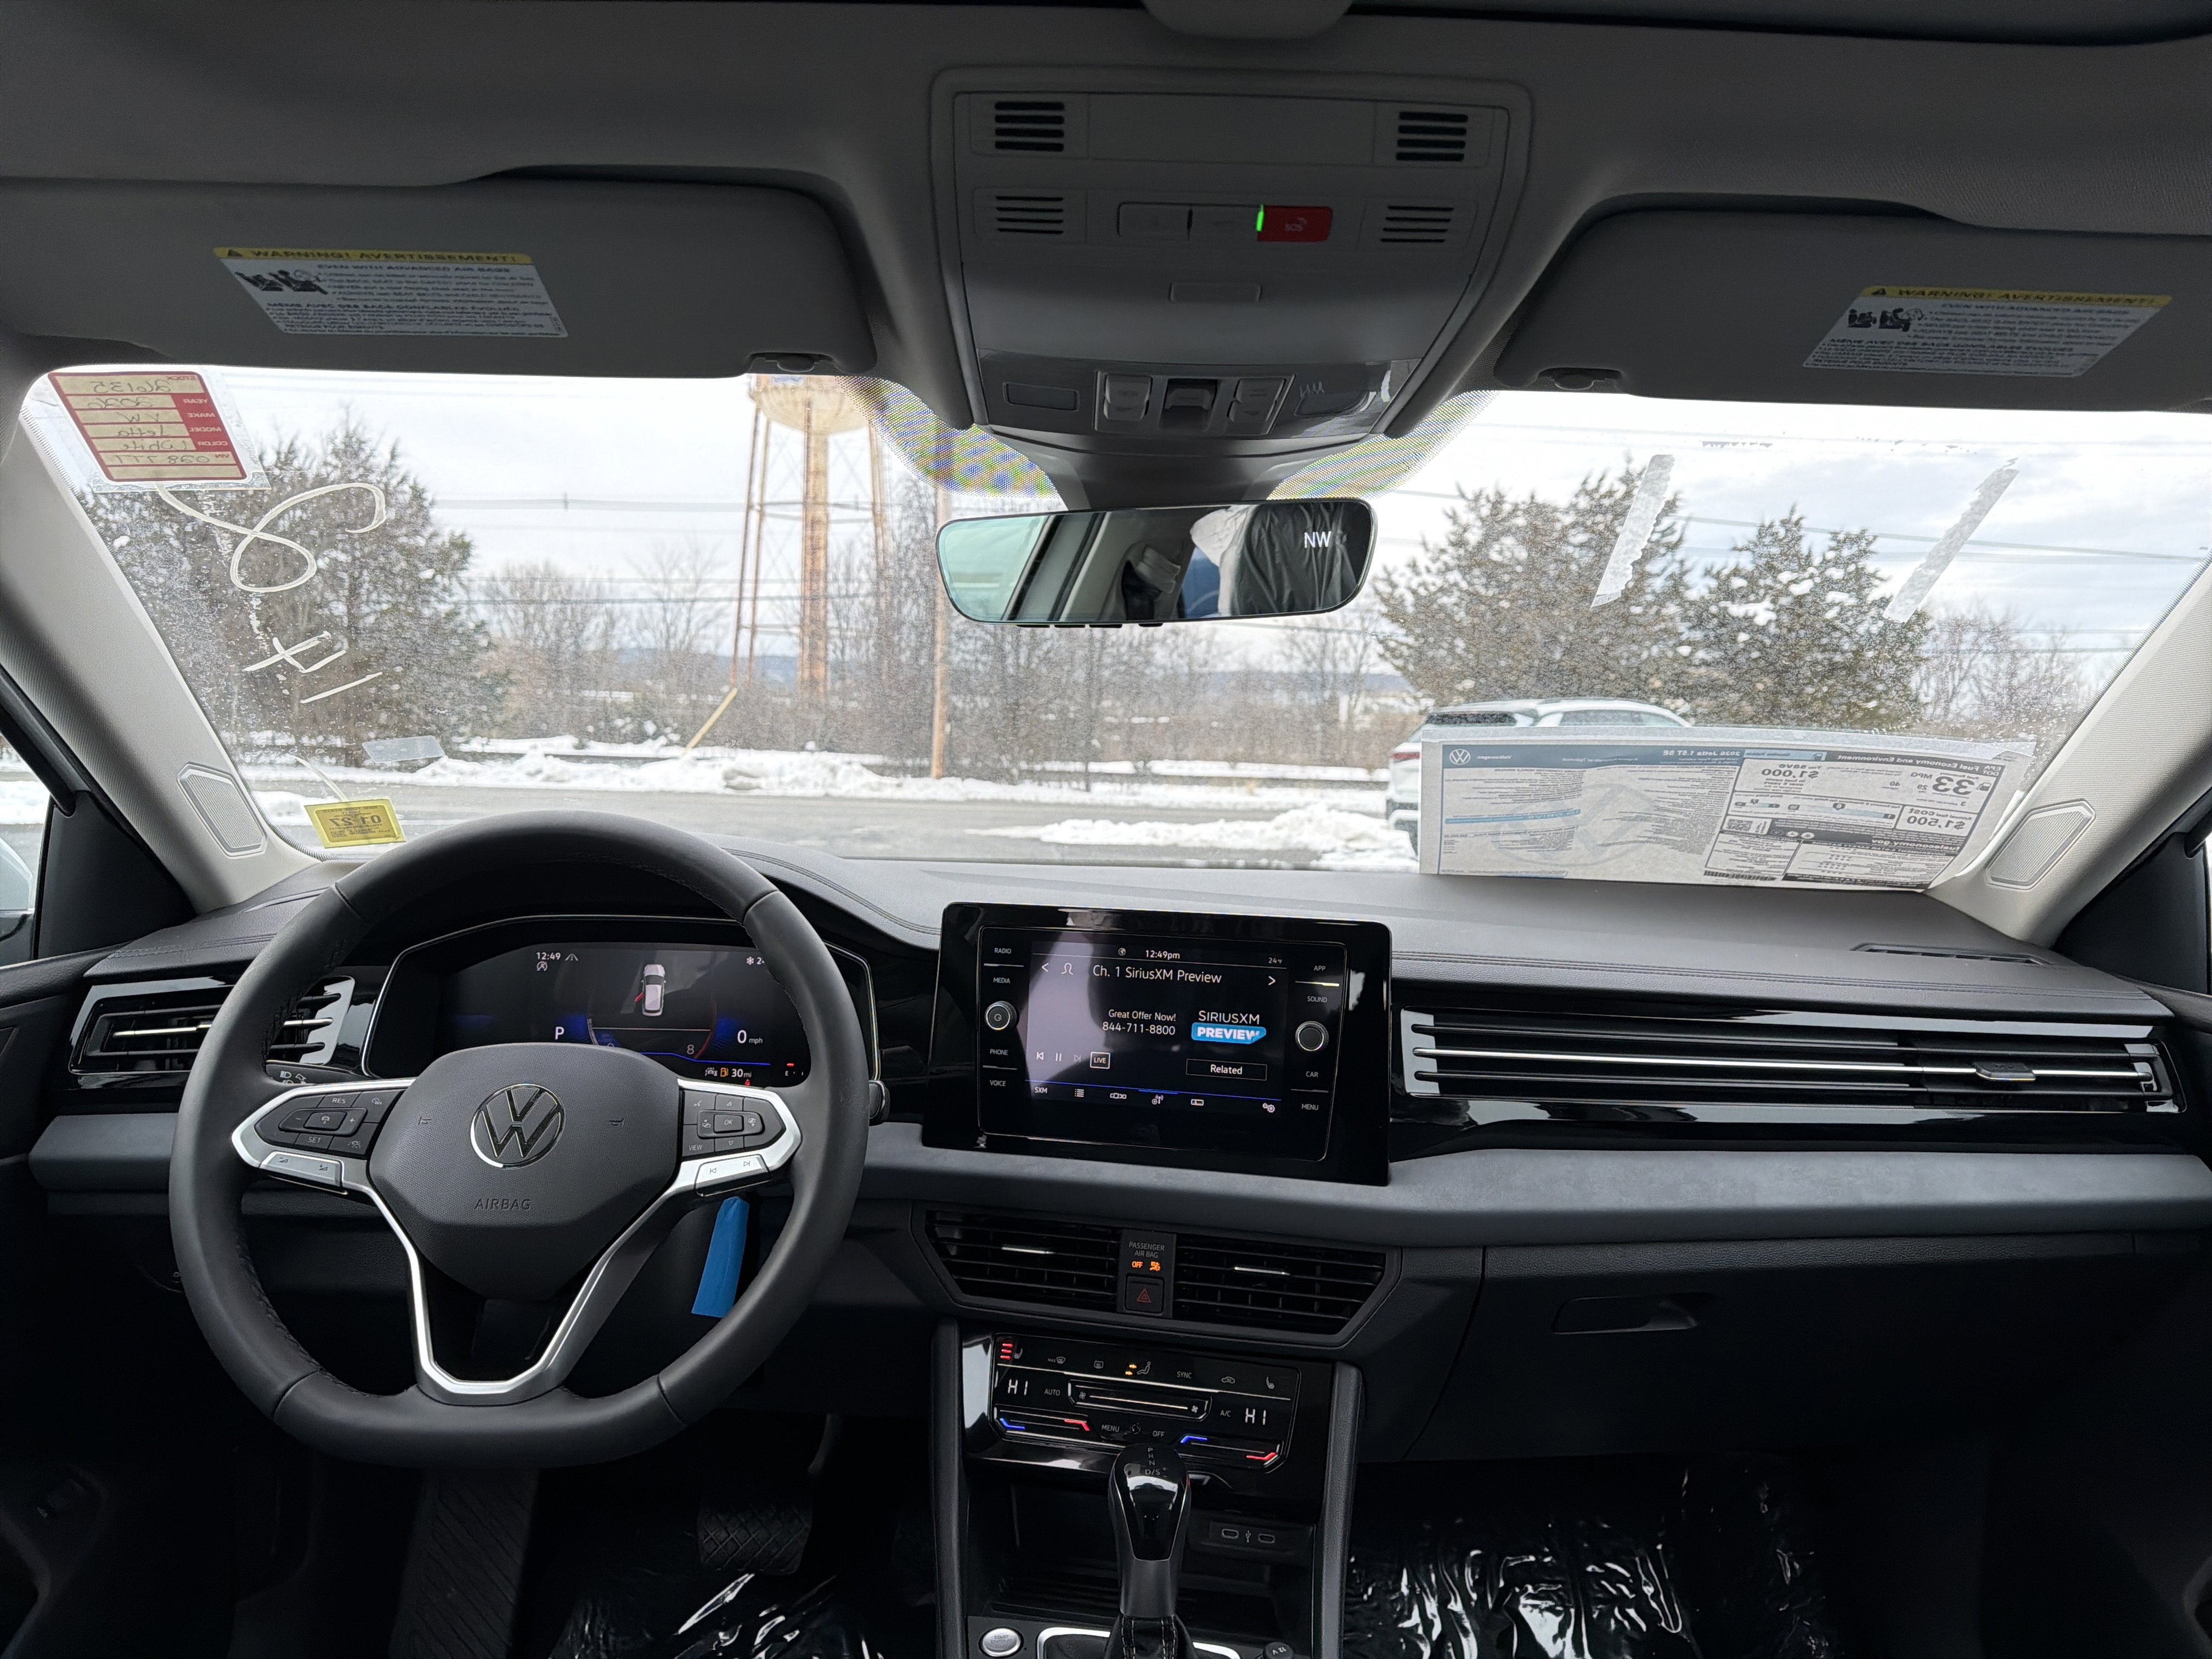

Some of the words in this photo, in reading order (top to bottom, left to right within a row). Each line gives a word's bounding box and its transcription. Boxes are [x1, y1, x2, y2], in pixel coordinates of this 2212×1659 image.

[1304, 531, 1331, 548] NW
[536, 952, 561, 960] 12:49
[1146, 950, 1180, 960] 12:49pm
[1093, 964, 1110, 977] Ch.
[1115, 966, 1120, 977] 1
[1125, 967, 1173, 980] SiriusXM
[1177, 970, 1222, 983] Preview
[1108, 1009, 1130, 1019] Great
[1132, 1011, 1153, 1020] Offer
[1154, 1012, 1176, 1022] Now!
[1198, 1010, 1260, 1025] SIRIUSXM
[555, 1026, 565, 1040] P
[1102, 1021, 1176, 1035] 844-711-8800
[1197, 1026, 1261, 1040] PREVIEW
[737, 1030, 747, 1043] 0
[748, 1037, 763, 1045] mph
[686, 1044, 695, 1054] 8
[731, 1069, 743, 1077] 30
[1210, 1064, 1243, 1075] Related
[475, 1198, 532, 1210] AIRBAG
[1128, 1242, 1165, 1251] PASSENGER
[1008, 1379, 1028, 1396] HI
[1245, 1408, 1266, 1425] HI
